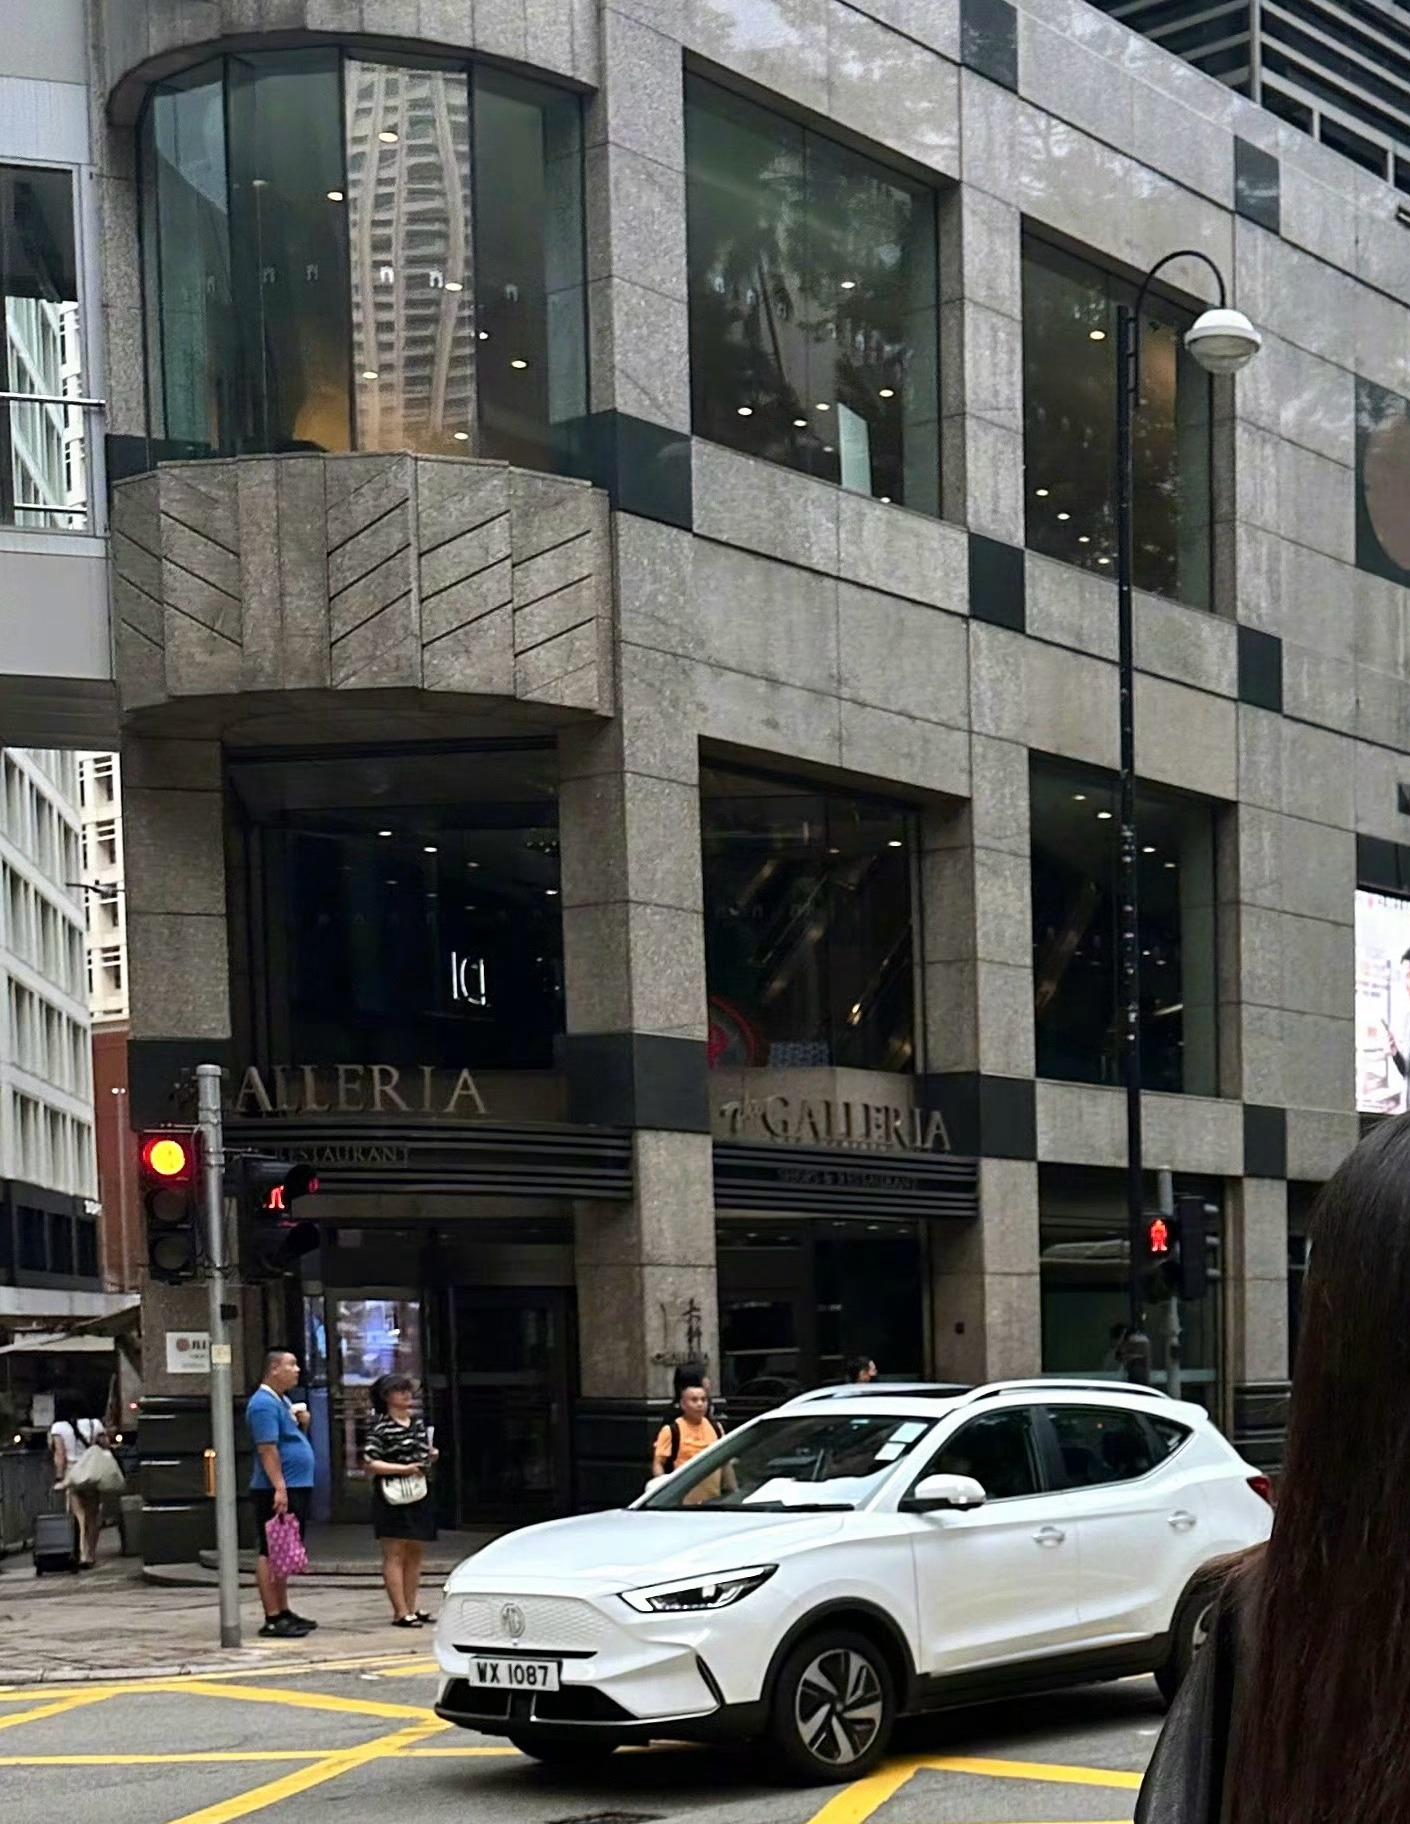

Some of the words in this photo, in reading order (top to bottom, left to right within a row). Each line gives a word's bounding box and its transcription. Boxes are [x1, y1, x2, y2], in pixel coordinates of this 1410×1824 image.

[230, 1064, 492, 1114] ALLERIA
[761, 1096, 952, 1152] GALLERIA
[476, 1661, 501, 1684] WX
[507, 1662, 549, 1687] 1087
